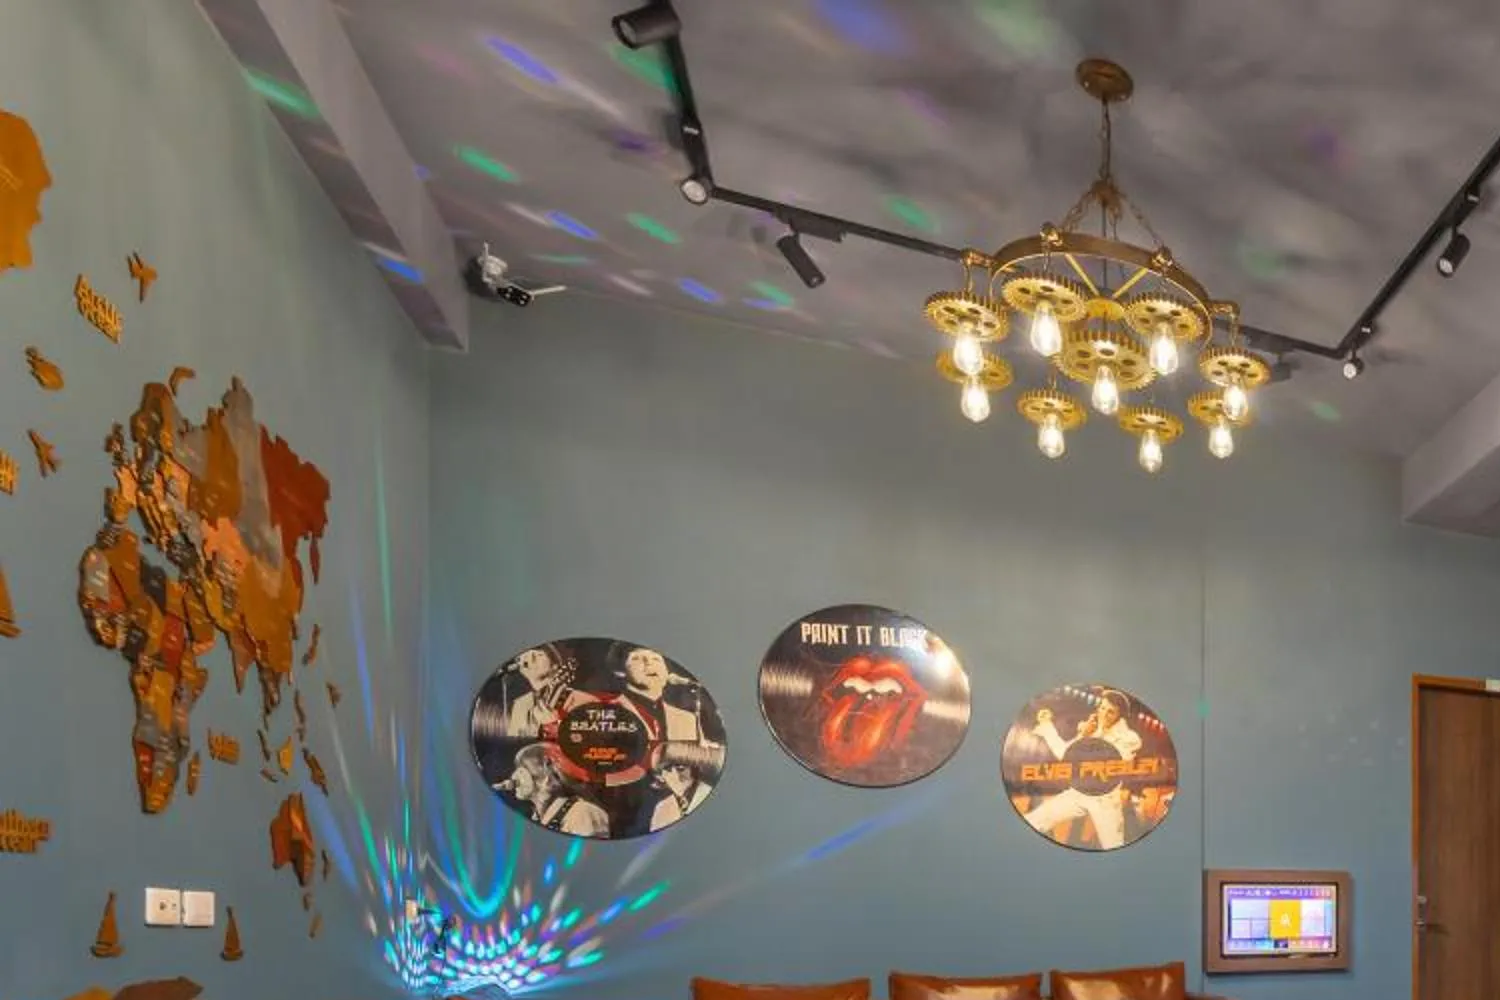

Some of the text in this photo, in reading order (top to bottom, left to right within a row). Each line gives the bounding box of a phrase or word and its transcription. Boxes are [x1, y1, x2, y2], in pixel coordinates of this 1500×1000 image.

[801, 622, 849, 646] PAINT
[855, 625, 873, 647] IT
[586, 709, 616, 720] THE
[570, 721, 638, 733] BEATLES
[1021, 763, 1072, 782] ELVIS
